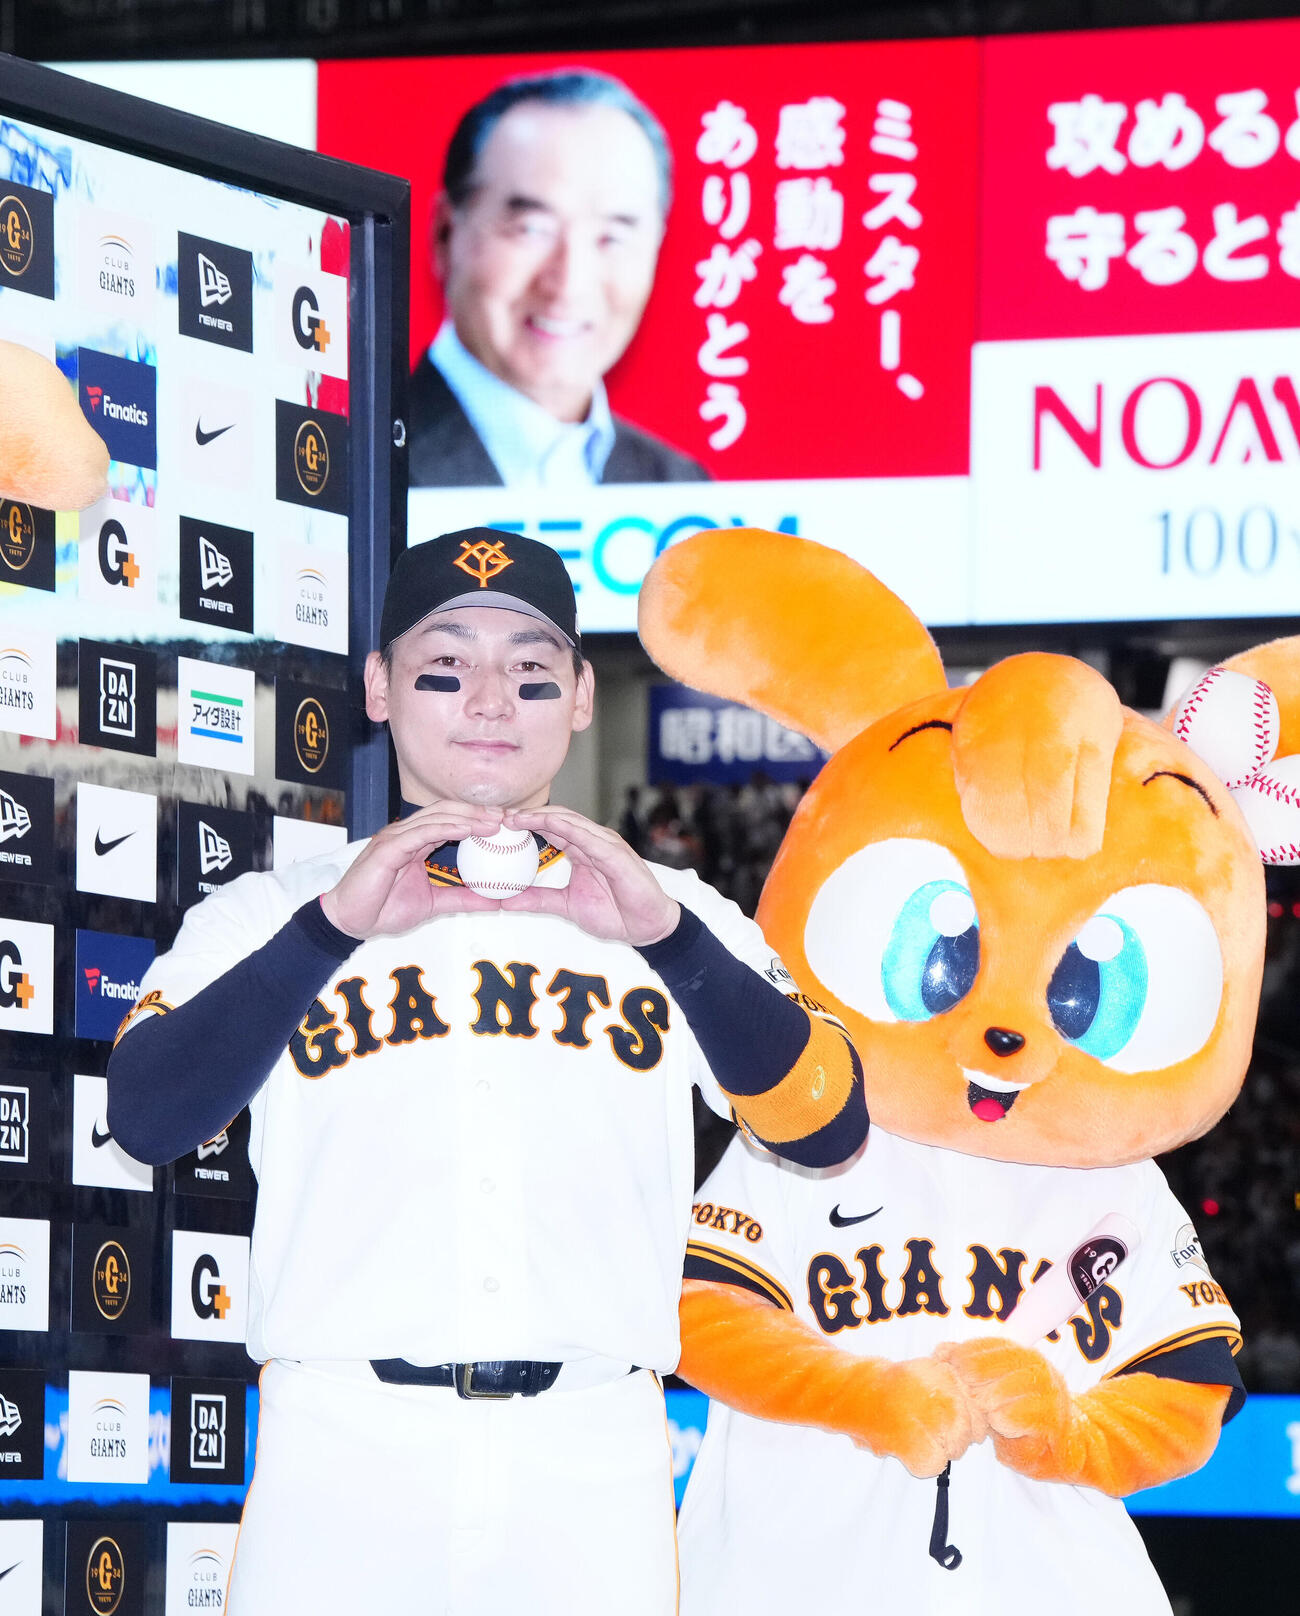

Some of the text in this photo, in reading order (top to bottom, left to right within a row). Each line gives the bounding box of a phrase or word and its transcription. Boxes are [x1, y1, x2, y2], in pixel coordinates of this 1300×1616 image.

[1045, 86, 1300, 178] 攻める
[775, 96, 846, 323] 感動を
[7, 210, 20, 249] G
[104, 256, 129, 271] CLUB
[863, 97, 924, 400] ミスター、
[99, 271, 135, 298] GIANTS
[694, 99, 763, 451] ありがとう
[103, 394, 148, 426] Fanatics
[306, 434, 318, 471] G
[9, 505, 22, 544] G
[300, 588, 324, 602] CLUB
[296, 603, 329, 627] GIANTS
[2, 670, 28, 683] CLUB
[192, 703, 242, 732] アイダ設計
[305, 712, 318, 748] G
[101, 975, 140, 1001] Fanatic
[289, 959, 671, 1080] GIANTS
[105, 1255, 119, 1294] G
[807, 1237, 1124, 1364] GIANS
[96, 1422, 121, 1432] CLUB
[90, 1438, 127, 1458] GIANTS
[99, 1552, 113, 1590] G
[193, 1572, 218, 1582] CLUB
[188, 1588, 223, 1607] GIANTS
